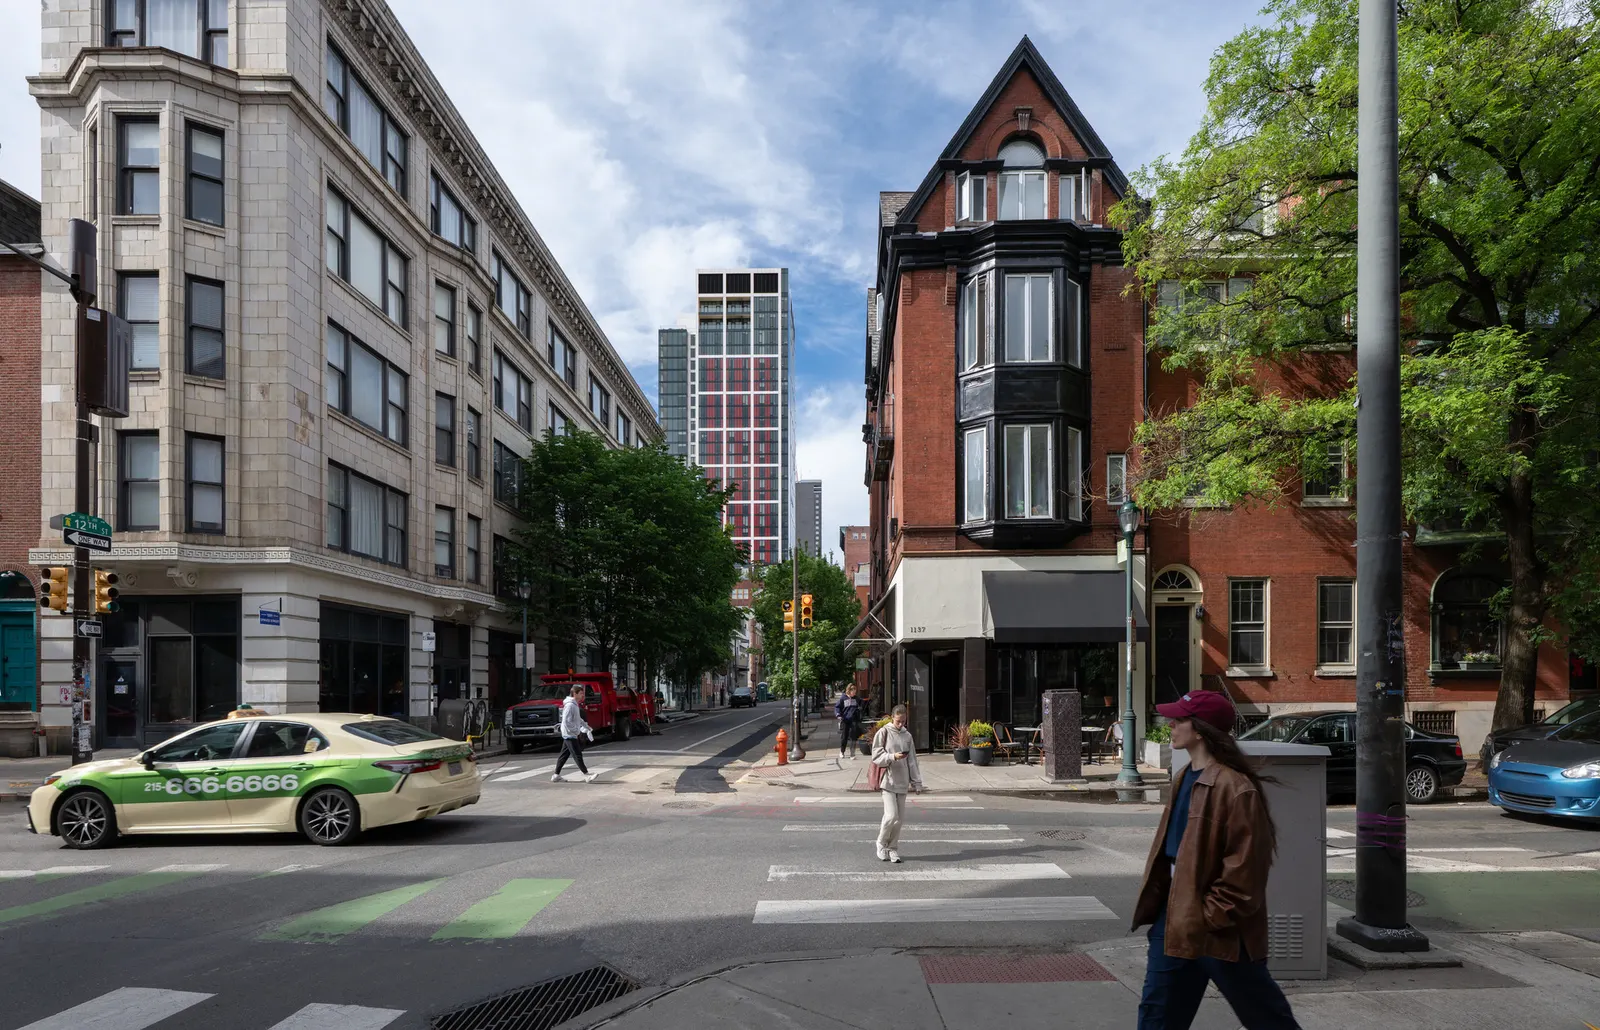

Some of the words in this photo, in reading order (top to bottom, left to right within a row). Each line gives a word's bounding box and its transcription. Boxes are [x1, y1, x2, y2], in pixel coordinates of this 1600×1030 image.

[74, 519, 98, 531] 12TH
[101, 527, 109, 536] ST
[78, 535, 92, 544] ONE
[93, 537, 108, 547] WAY
[910, 626, 926, 634] 1137
